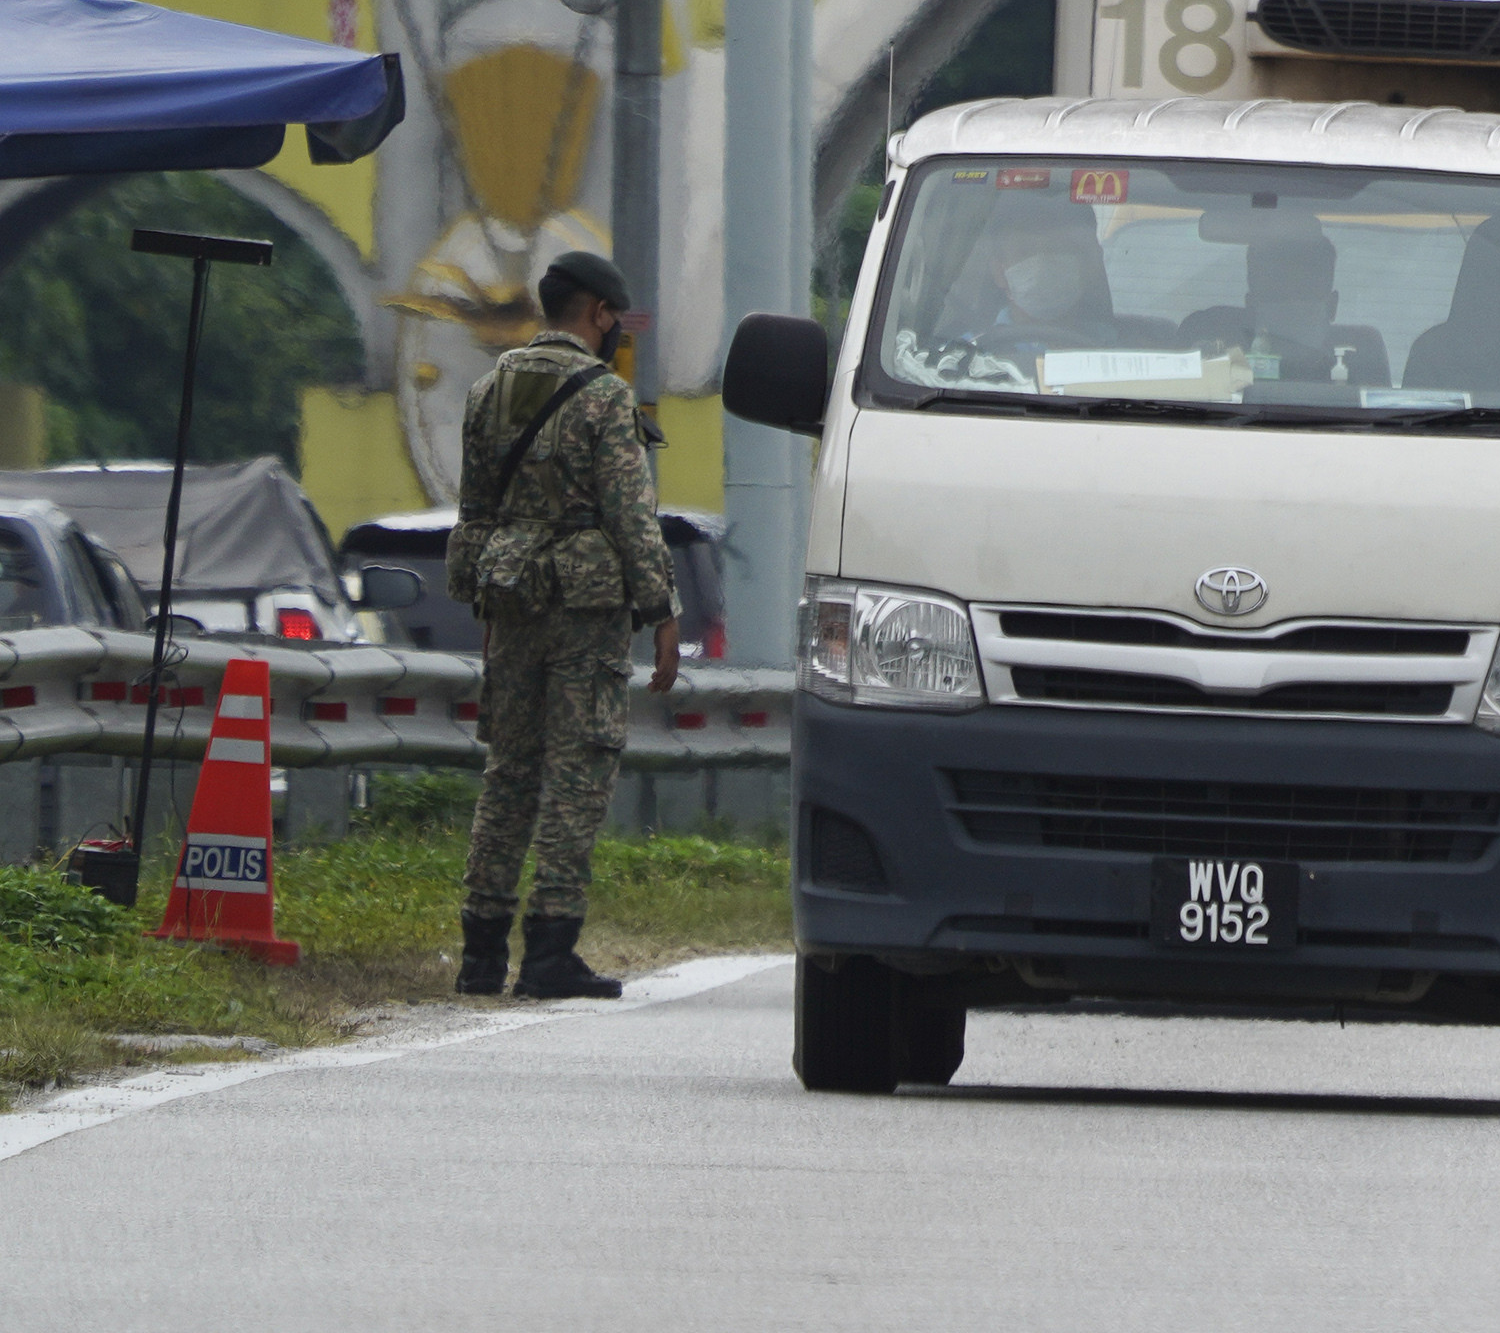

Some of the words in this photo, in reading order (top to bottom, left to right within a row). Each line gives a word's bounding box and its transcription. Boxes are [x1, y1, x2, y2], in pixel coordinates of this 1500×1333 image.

[185, 846, 262, 880] POLIS
[1189, 860, 1264, 904] WVQ
[1180, 901, 1270, 944] 9152
